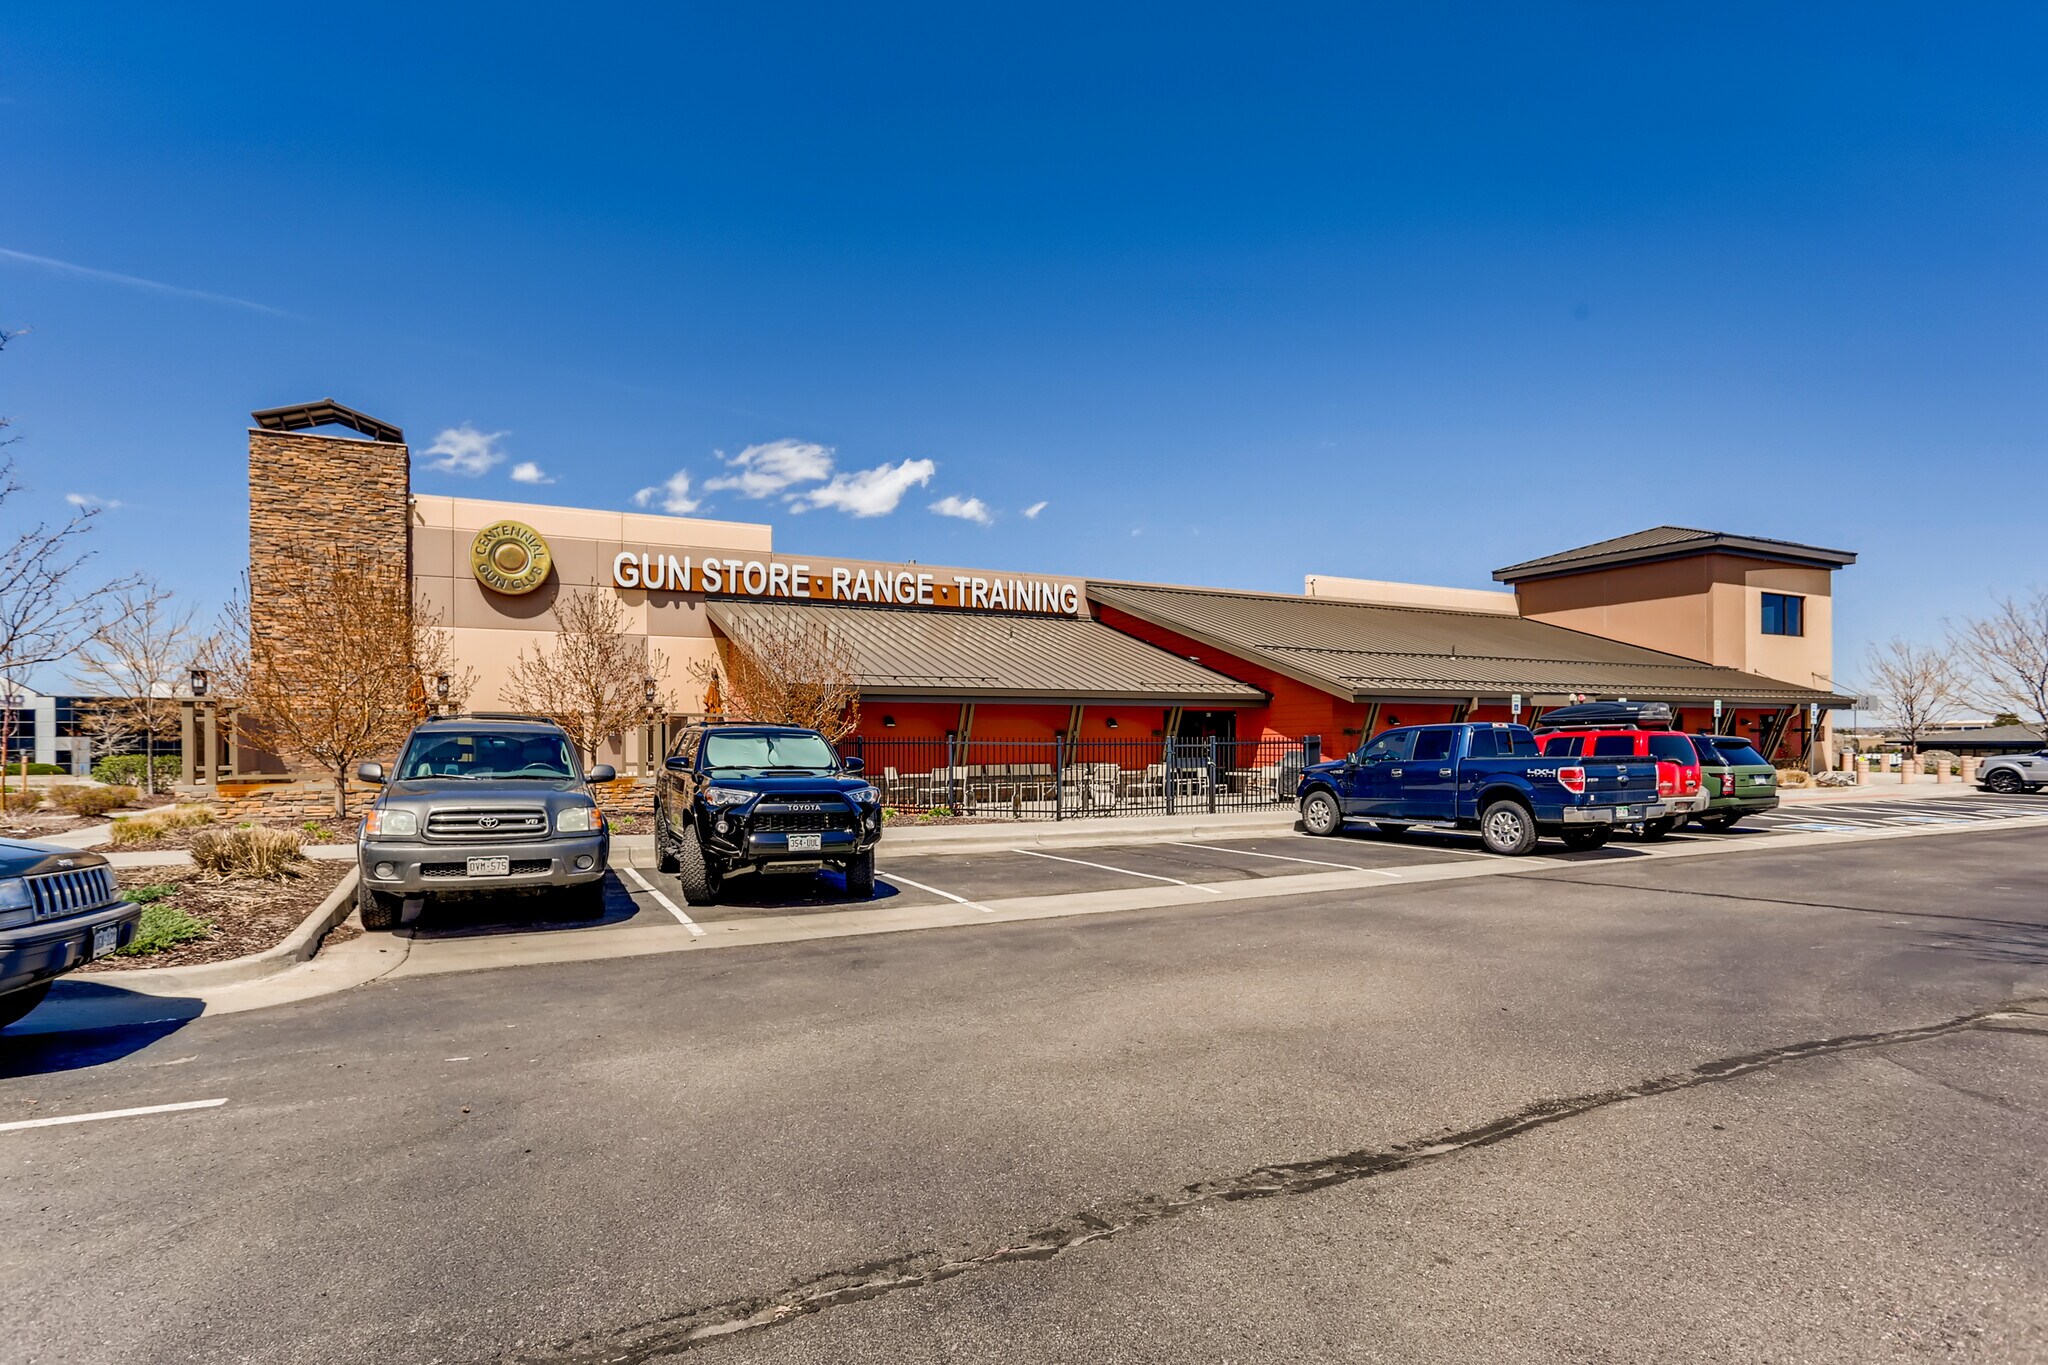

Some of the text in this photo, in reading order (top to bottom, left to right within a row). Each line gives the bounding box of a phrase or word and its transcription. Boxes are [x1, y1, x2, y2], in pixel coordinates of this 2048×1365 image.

[475, 525, 545, 559] CENTENNIAL
[478, 563, 543, 590] GUN CLUB
[613, 551, 1079, 614] GUN STORE RANGE TRAINING
